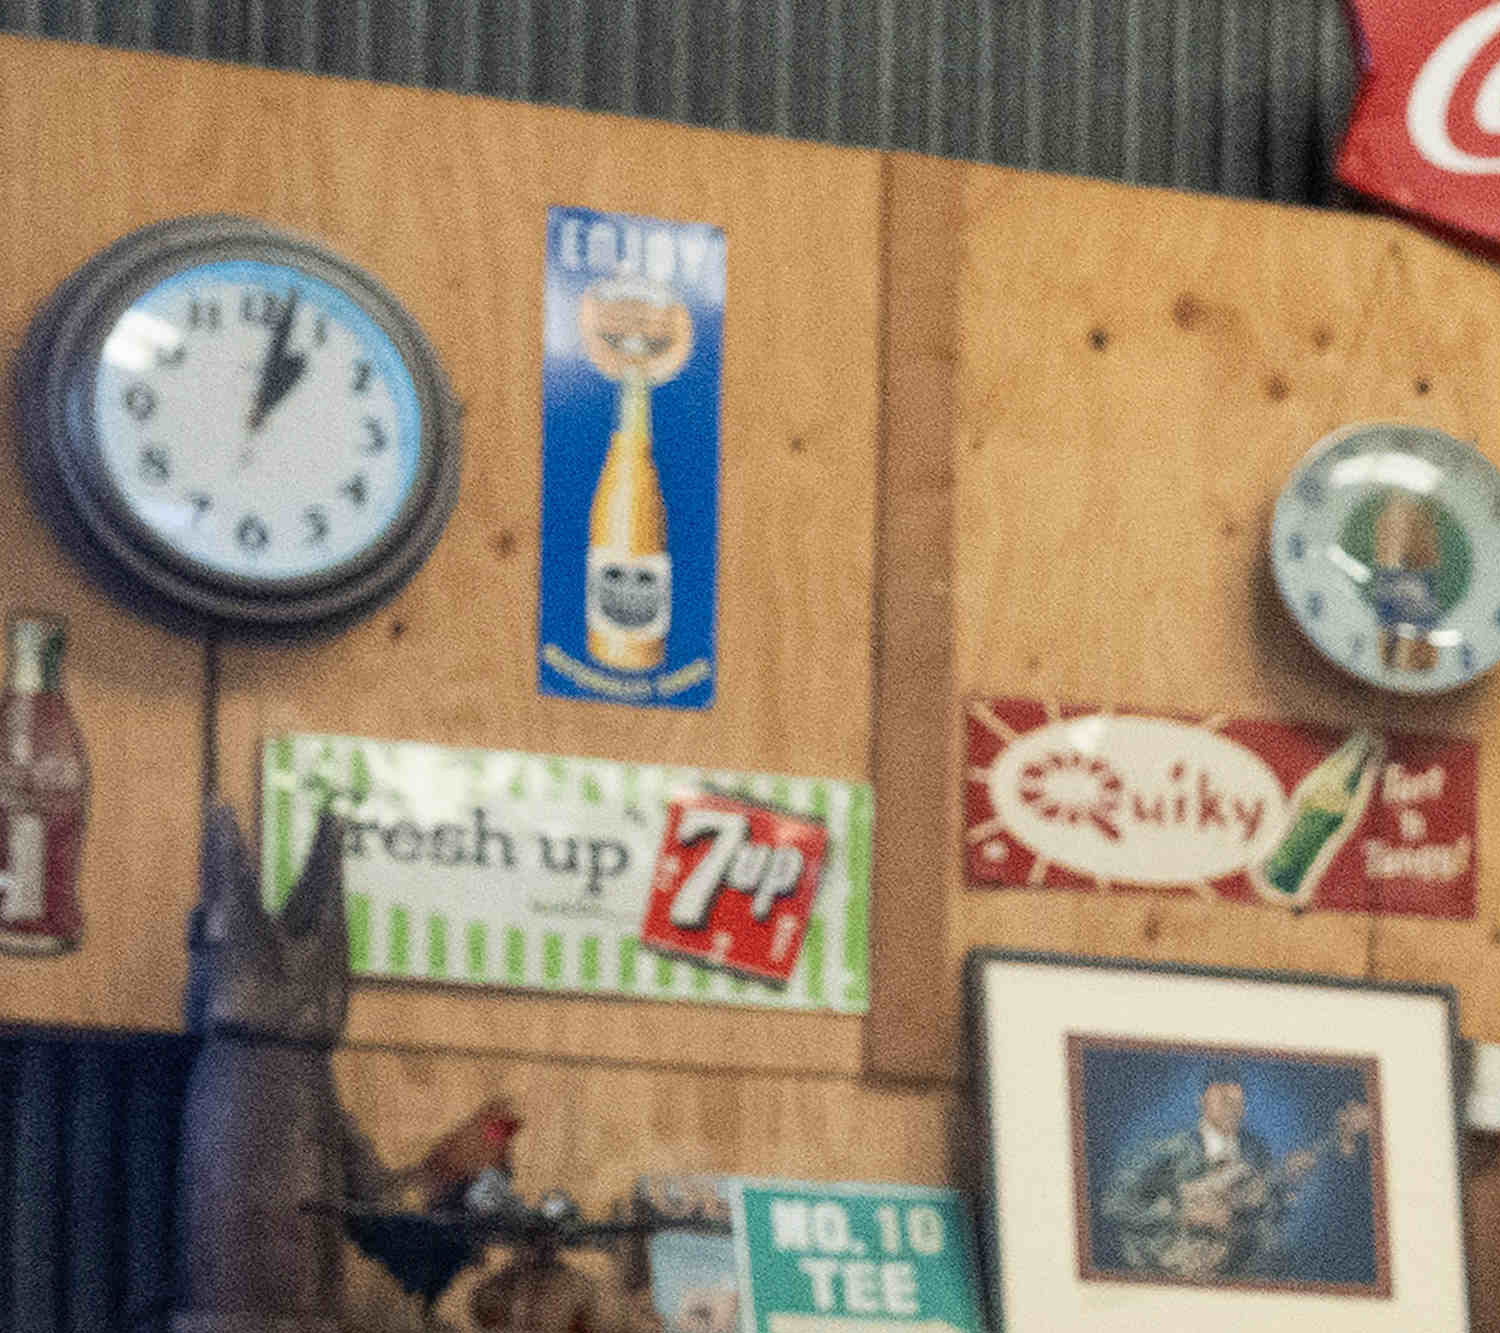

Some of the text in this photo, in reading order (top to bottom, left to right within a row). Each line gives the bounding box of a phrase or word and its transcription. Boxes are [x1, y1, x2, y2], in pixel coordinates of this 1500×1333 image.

[539, 812, 630, 893] up
[769, 1202, 866, 1253] NO.
[803, 1259, 920, 1314] TEE
